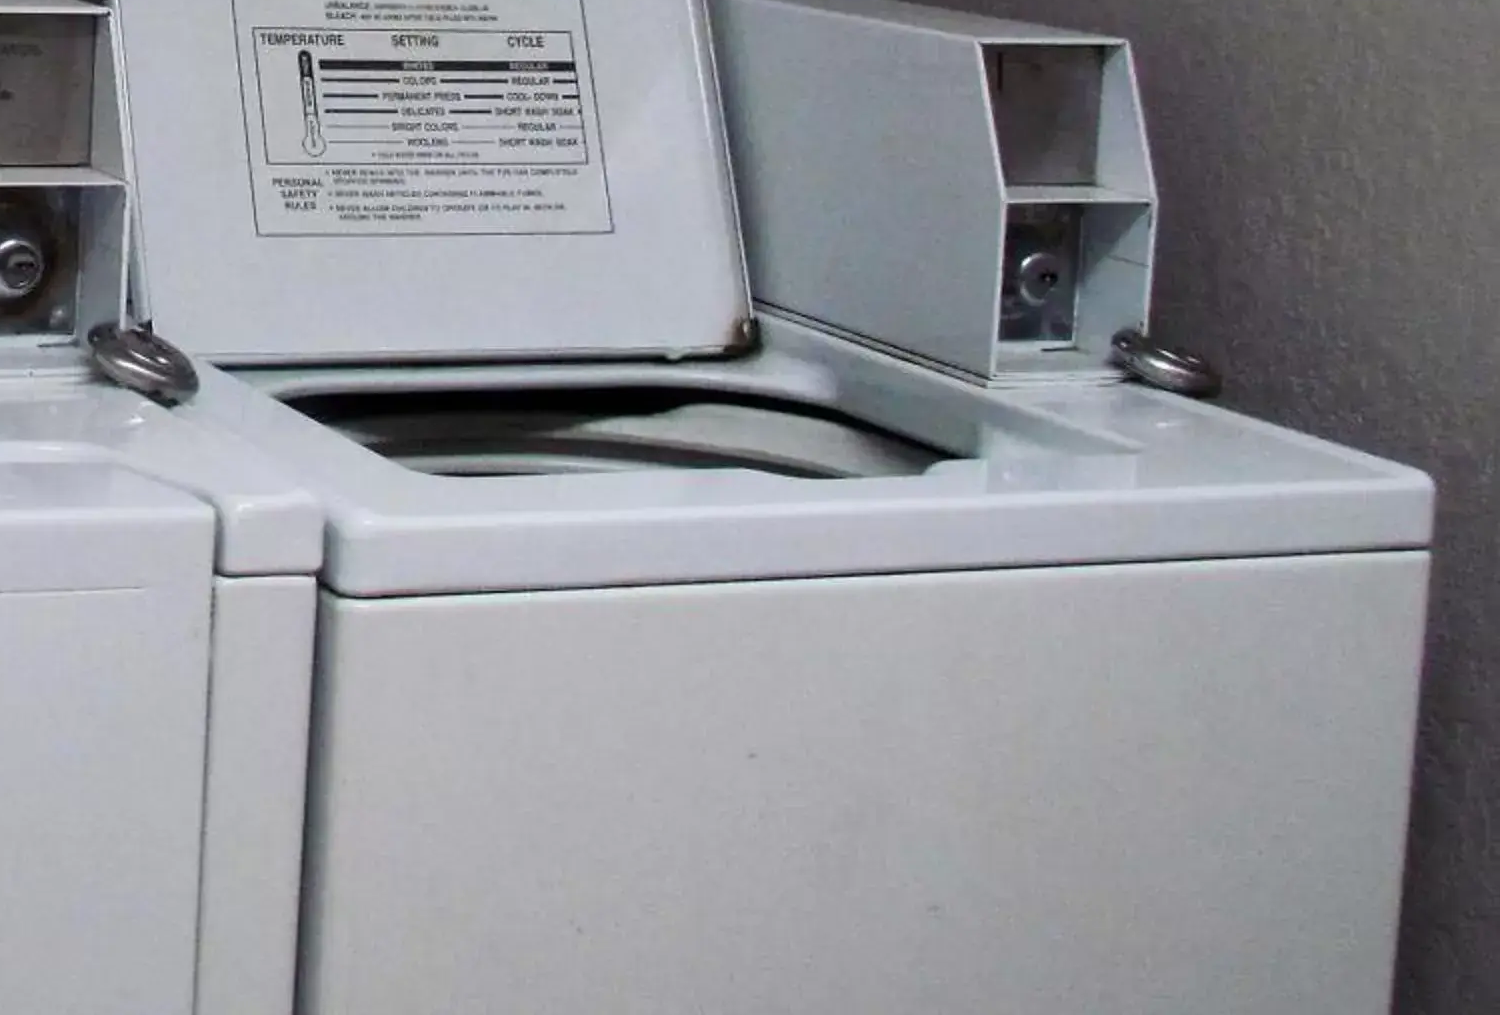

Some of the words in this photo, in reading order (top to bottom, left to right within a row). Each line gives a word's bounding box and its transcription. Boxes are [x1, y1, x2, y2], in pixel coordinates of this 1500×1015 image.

[260, 32, 345, 46] TEMPERATURE
[391, 34, 439, 47] SETTING
[507, 36, 544, 48] CYCLE
